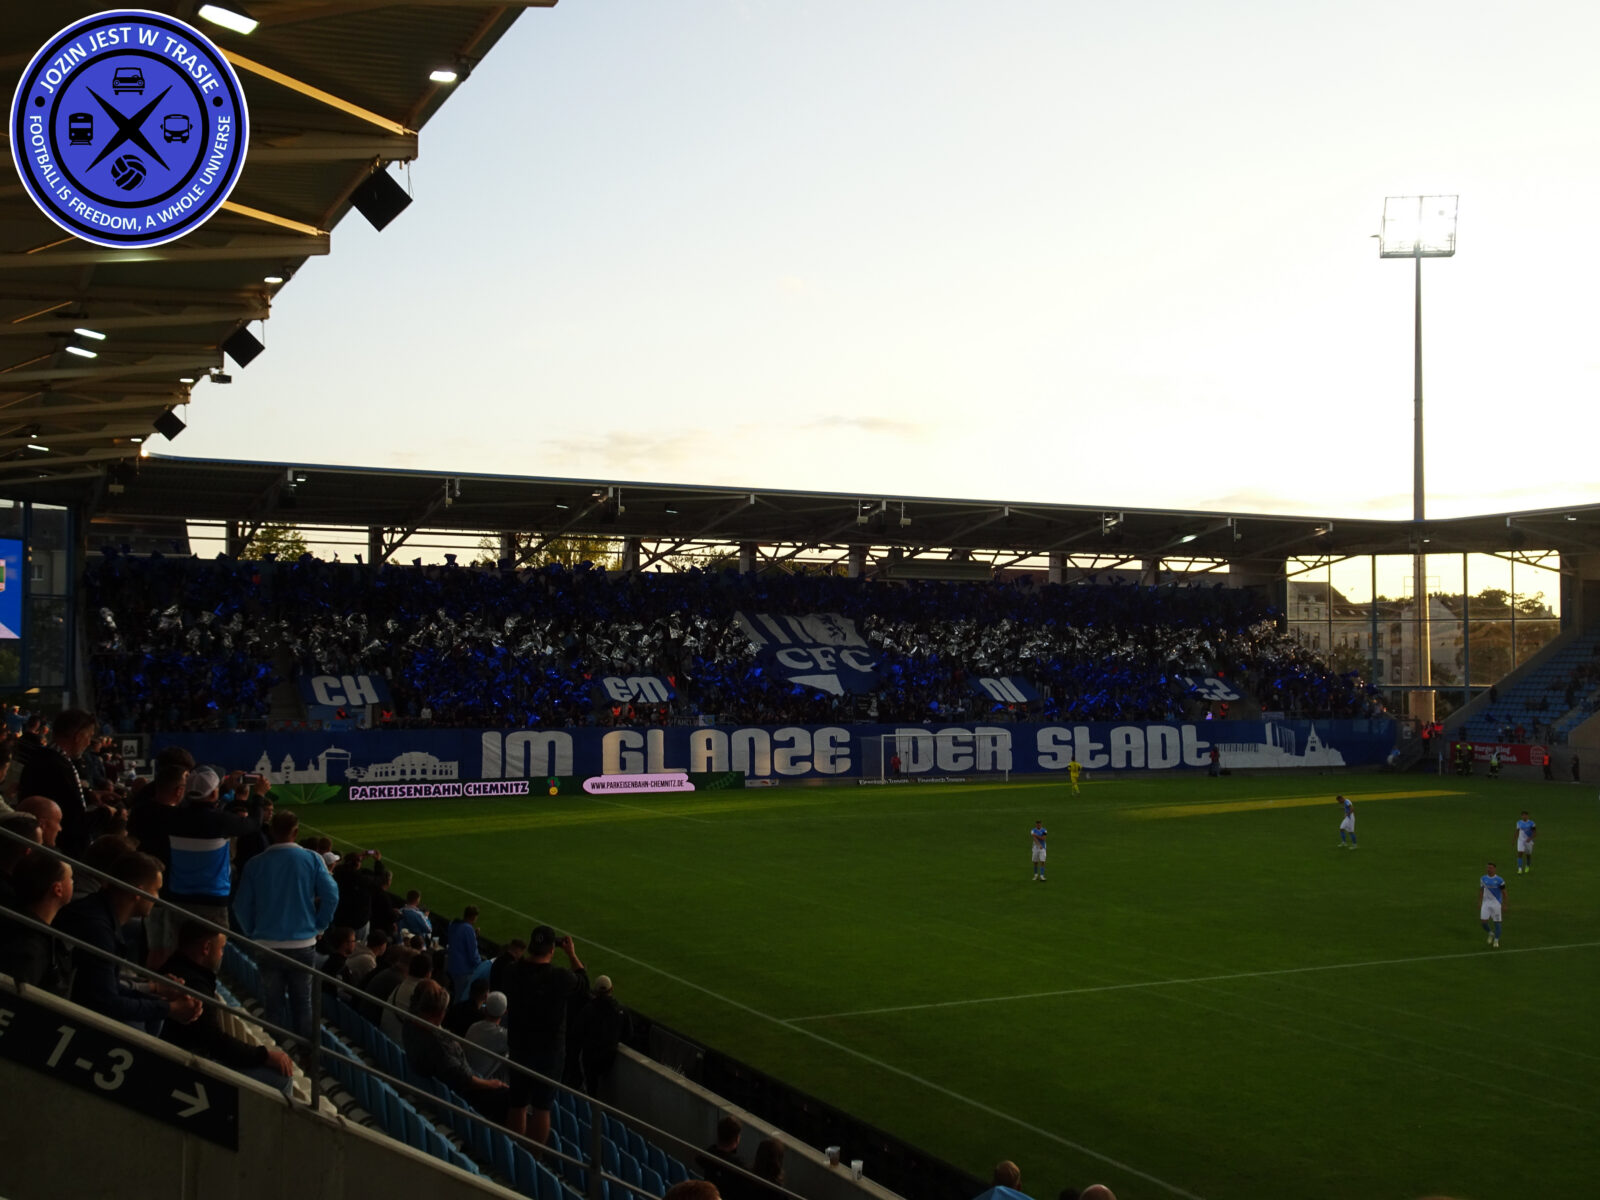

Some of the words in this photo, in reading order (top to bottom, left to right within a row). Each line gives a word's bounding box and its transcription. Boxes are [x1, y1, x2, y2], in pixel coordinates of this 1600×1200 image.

[776, 647, 877, 672] CFC
[311, 675, 380, 706] CH
[895, 727, 1013, 772] DER
[351, 784, 462, 799] PARKEISENBAHN
[465, 781, 530, 796] CHEMNITZ
[591, 779, 685, 790] WWW.PARKEISENBAHN-CHEMNITZ.DE
[46, 1024, 135, 1091] 1-3
